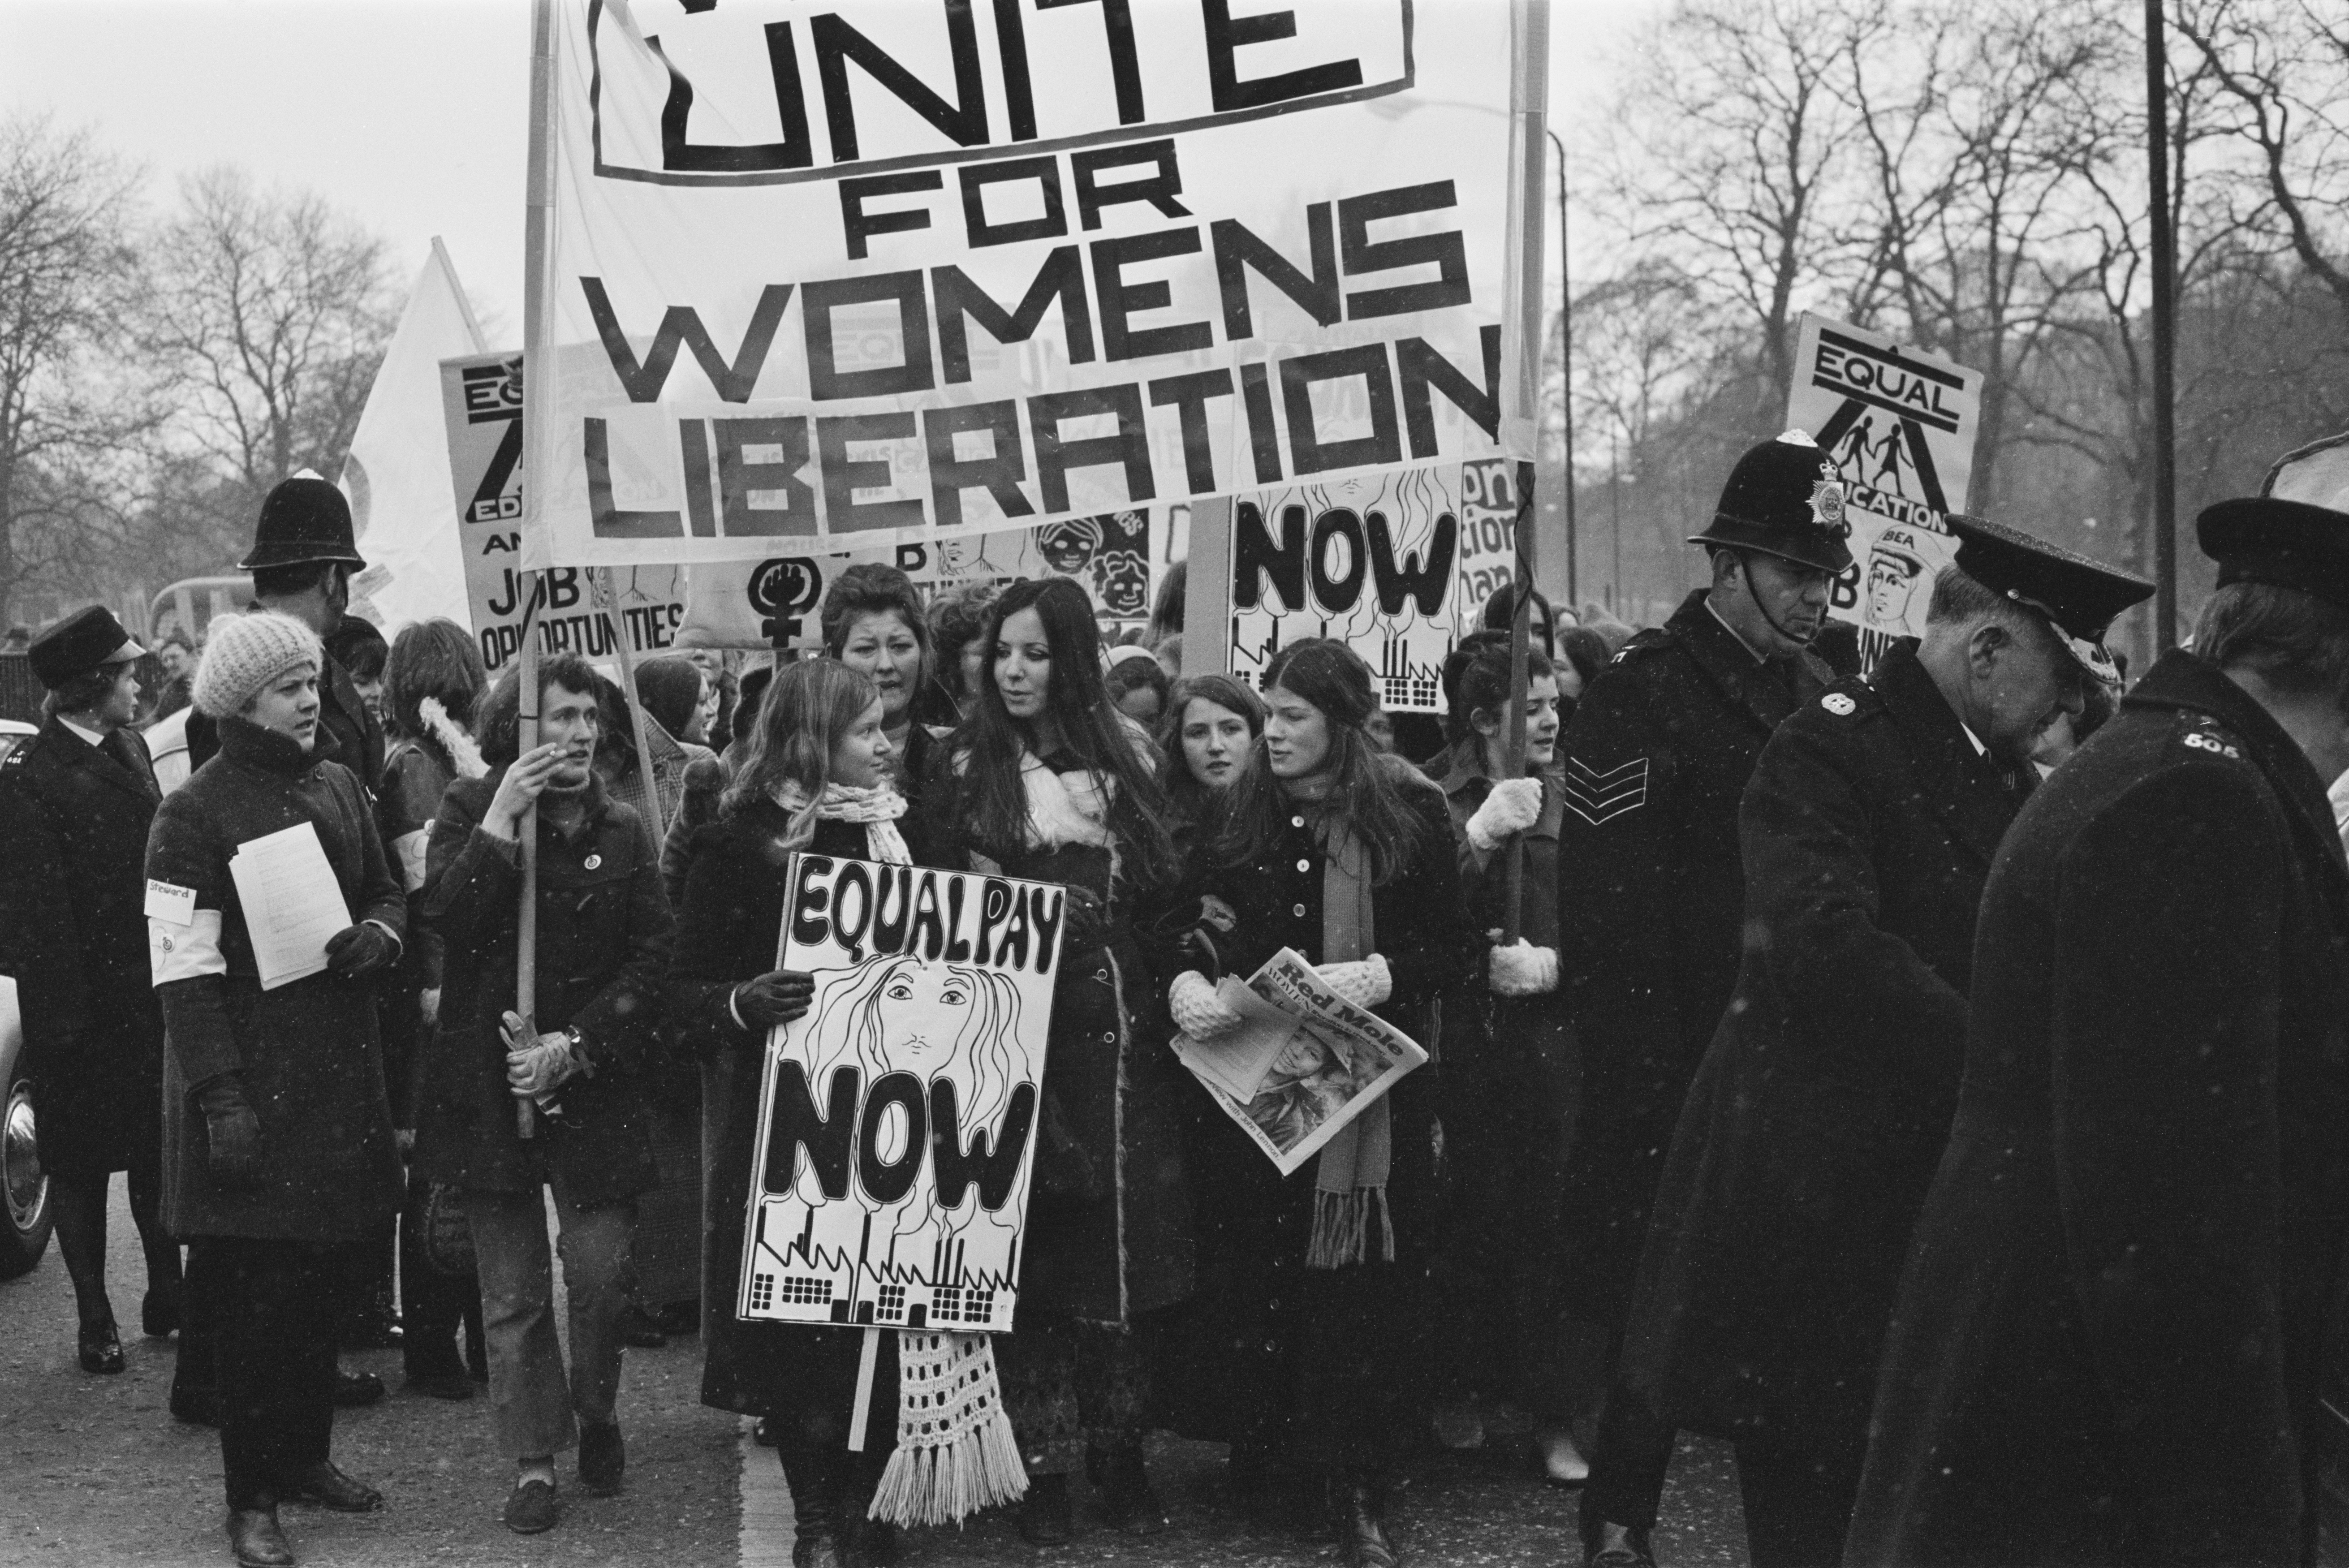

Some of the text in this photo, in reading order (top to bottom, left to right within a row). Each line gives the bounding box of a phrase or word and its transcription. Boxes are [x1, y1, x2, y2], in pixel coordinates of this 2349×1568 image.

[644, 0, 1363, 172] UNITE
[838, 138, 1194, 260] FOR
[578, 179, 1471, 404] WOMENS
[583, 323, 1502, 538] LIBERATION
[1815, 343, 1961, 421] EQUAL
[1233, 501, 1458, 617] NOW
[1842, 481, 1948, 534] UCATION
[1882, 530, 1914, 550] BEA
[481, 603, 685, 671] OPORTUNTIES
[149, 881, 190, 898] Steward
[790, 856, 1065, 975] EQUAL PAY
[1278, 961, 1404, 1056] Red Mole
[761, 1059, 1039, 1213] NOW
[1226, 1100, 1241, 1116] with
[1240, 1115, 1257, 1133] John
